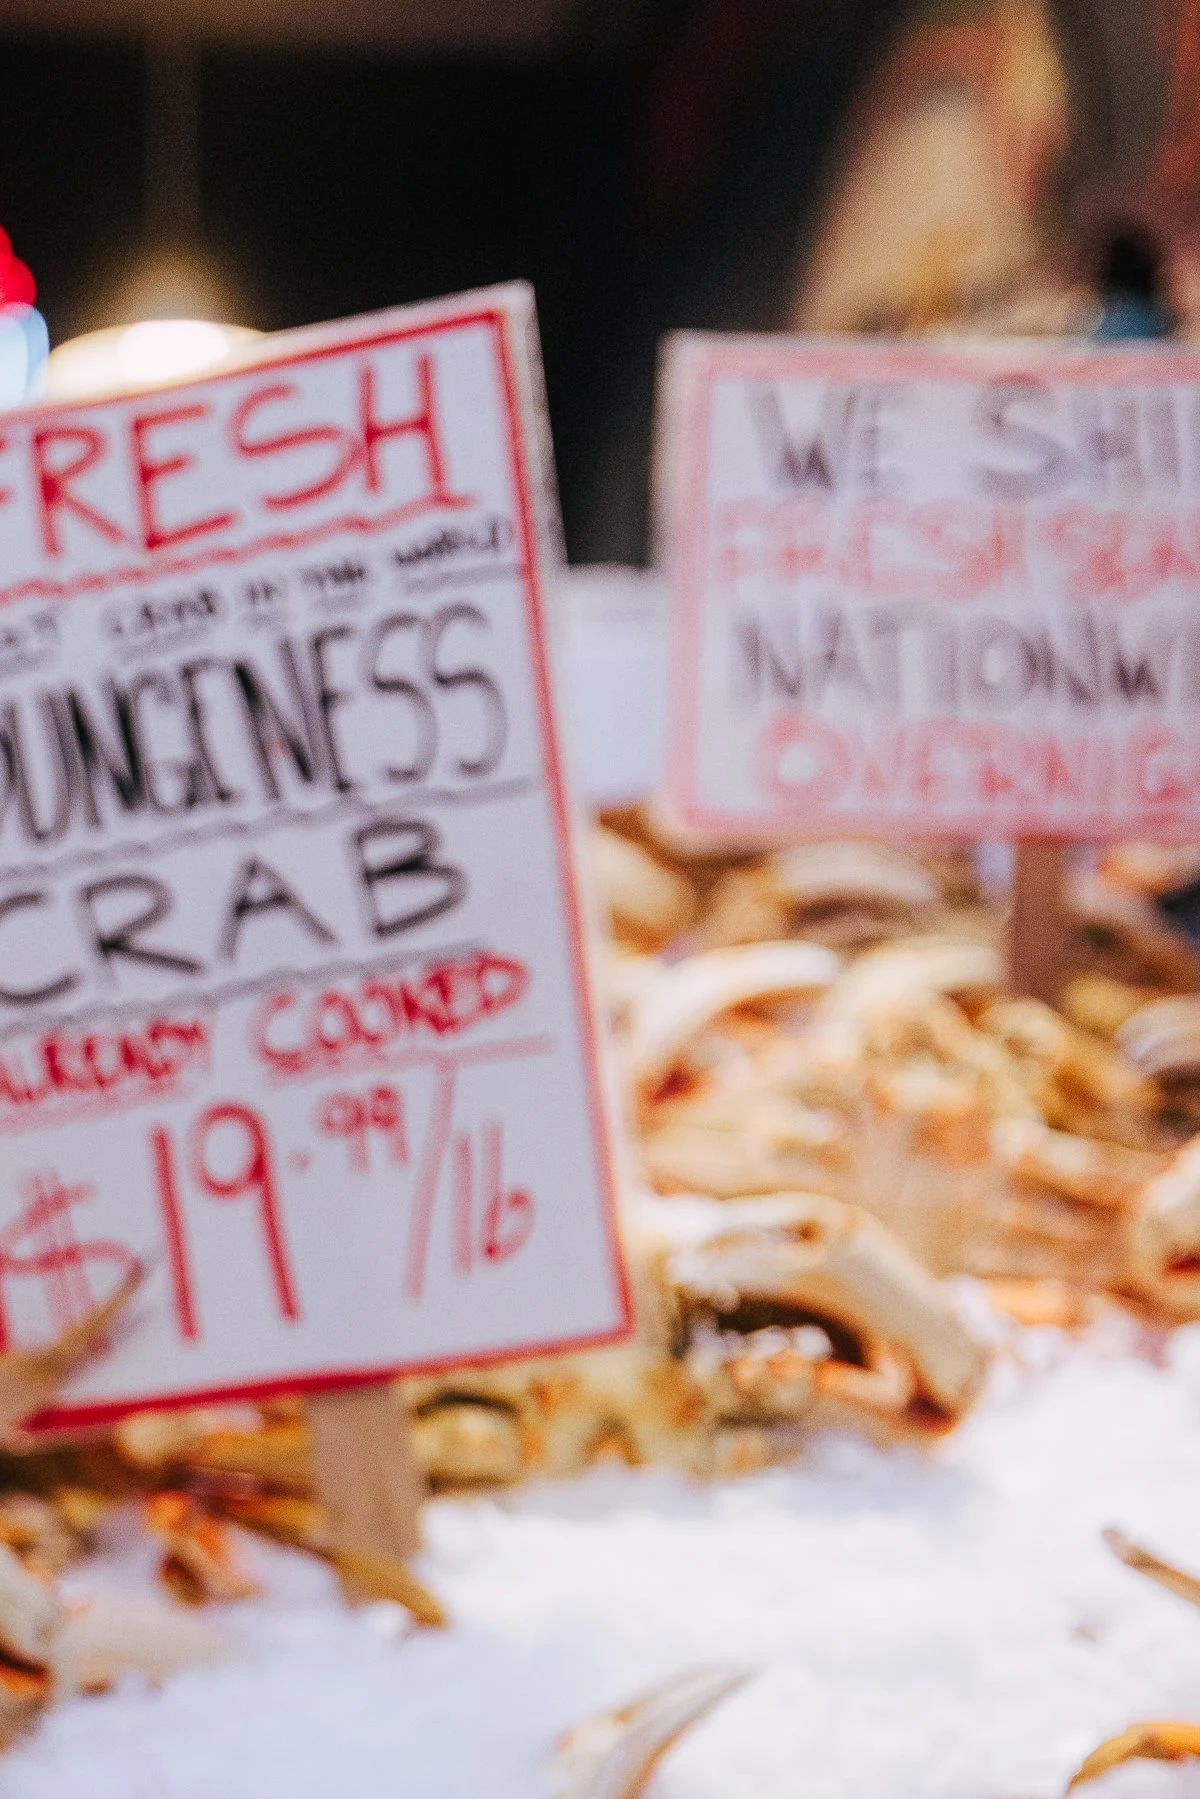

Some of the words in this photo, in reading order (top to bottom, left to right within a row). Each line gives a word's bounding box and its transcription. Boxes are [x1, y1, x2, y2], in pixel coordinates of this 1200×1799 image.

[745, 380, 910, 496] WE
[970, 372, 1200, 500] SHI
[1040, 500, 1200, 602] SEA
[248, 948, 534, 1074] COOKED
